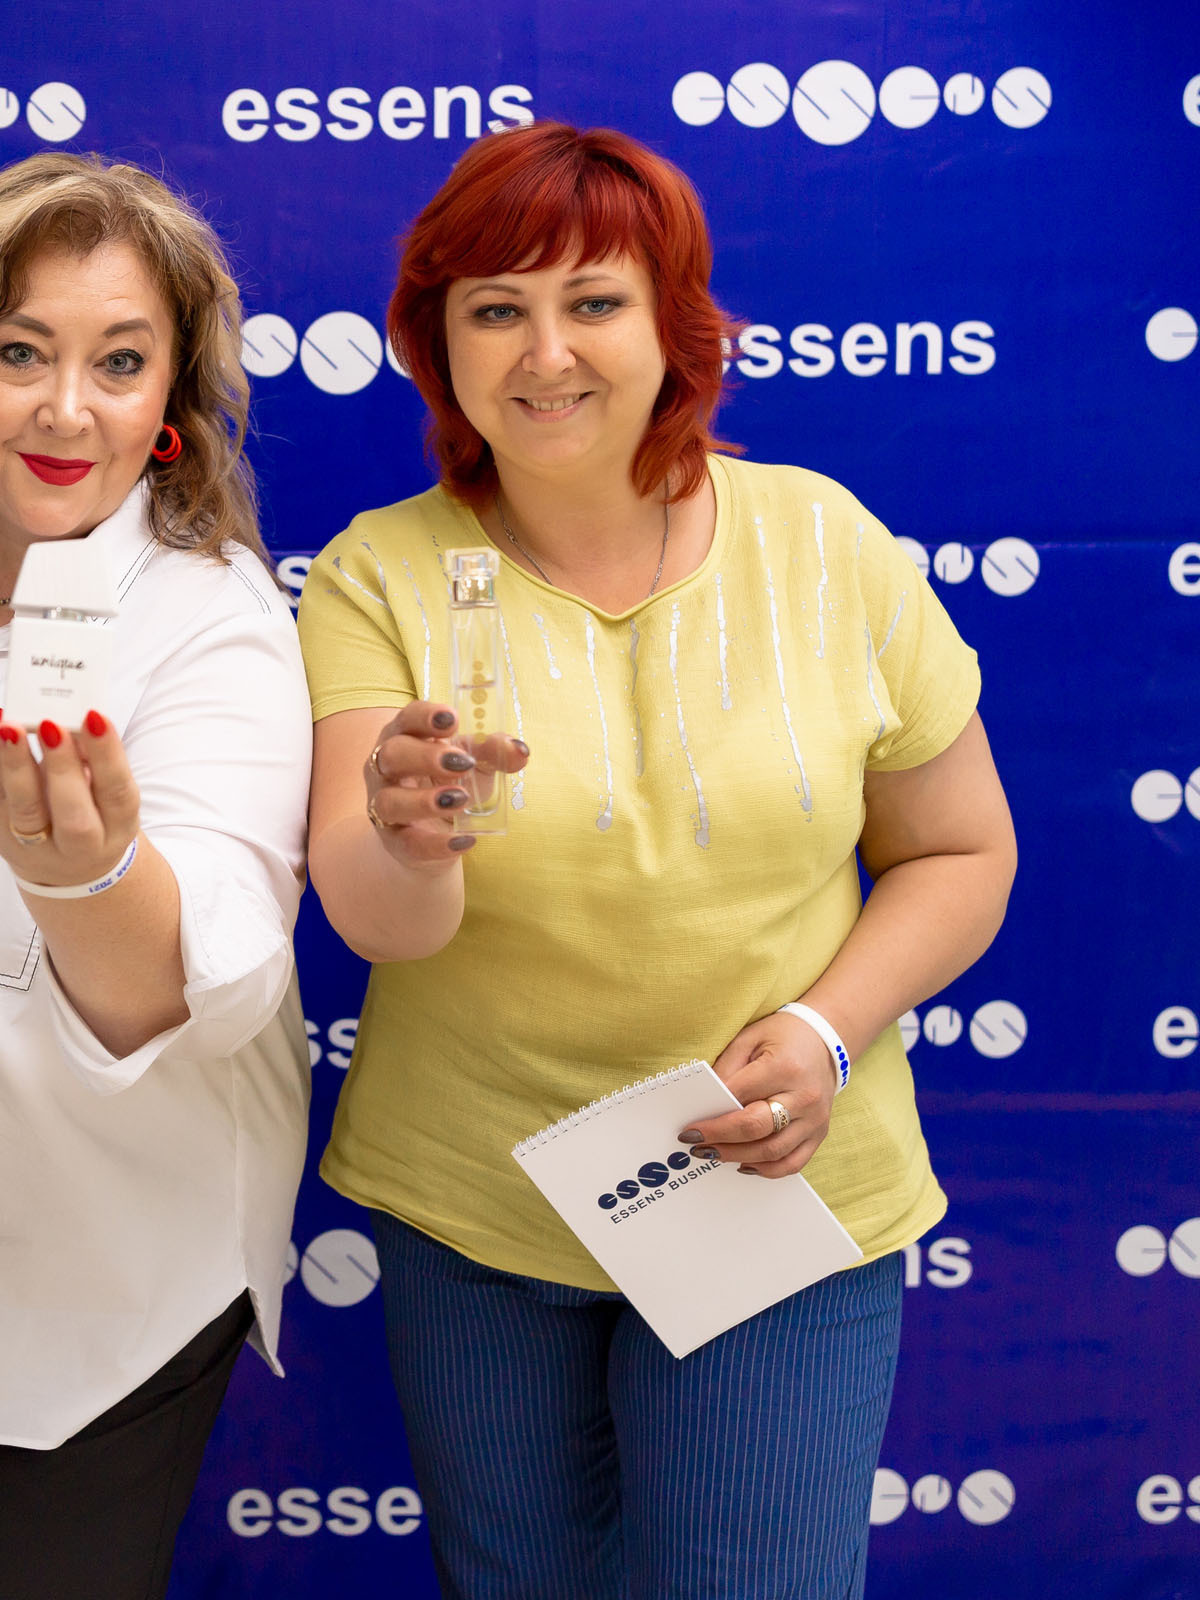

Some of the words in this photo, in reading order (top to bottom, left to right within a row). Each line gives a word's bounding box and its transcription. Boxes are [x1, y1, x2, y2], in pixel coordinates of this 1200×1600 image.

[222, 84, 535, 143] essens
[720, 320, 996, 379] ssens
[30, 654, 86, 680] unique
[610, 1188, 666, 1225] ESSENS
[227, 1484, 423, 1537] esse
